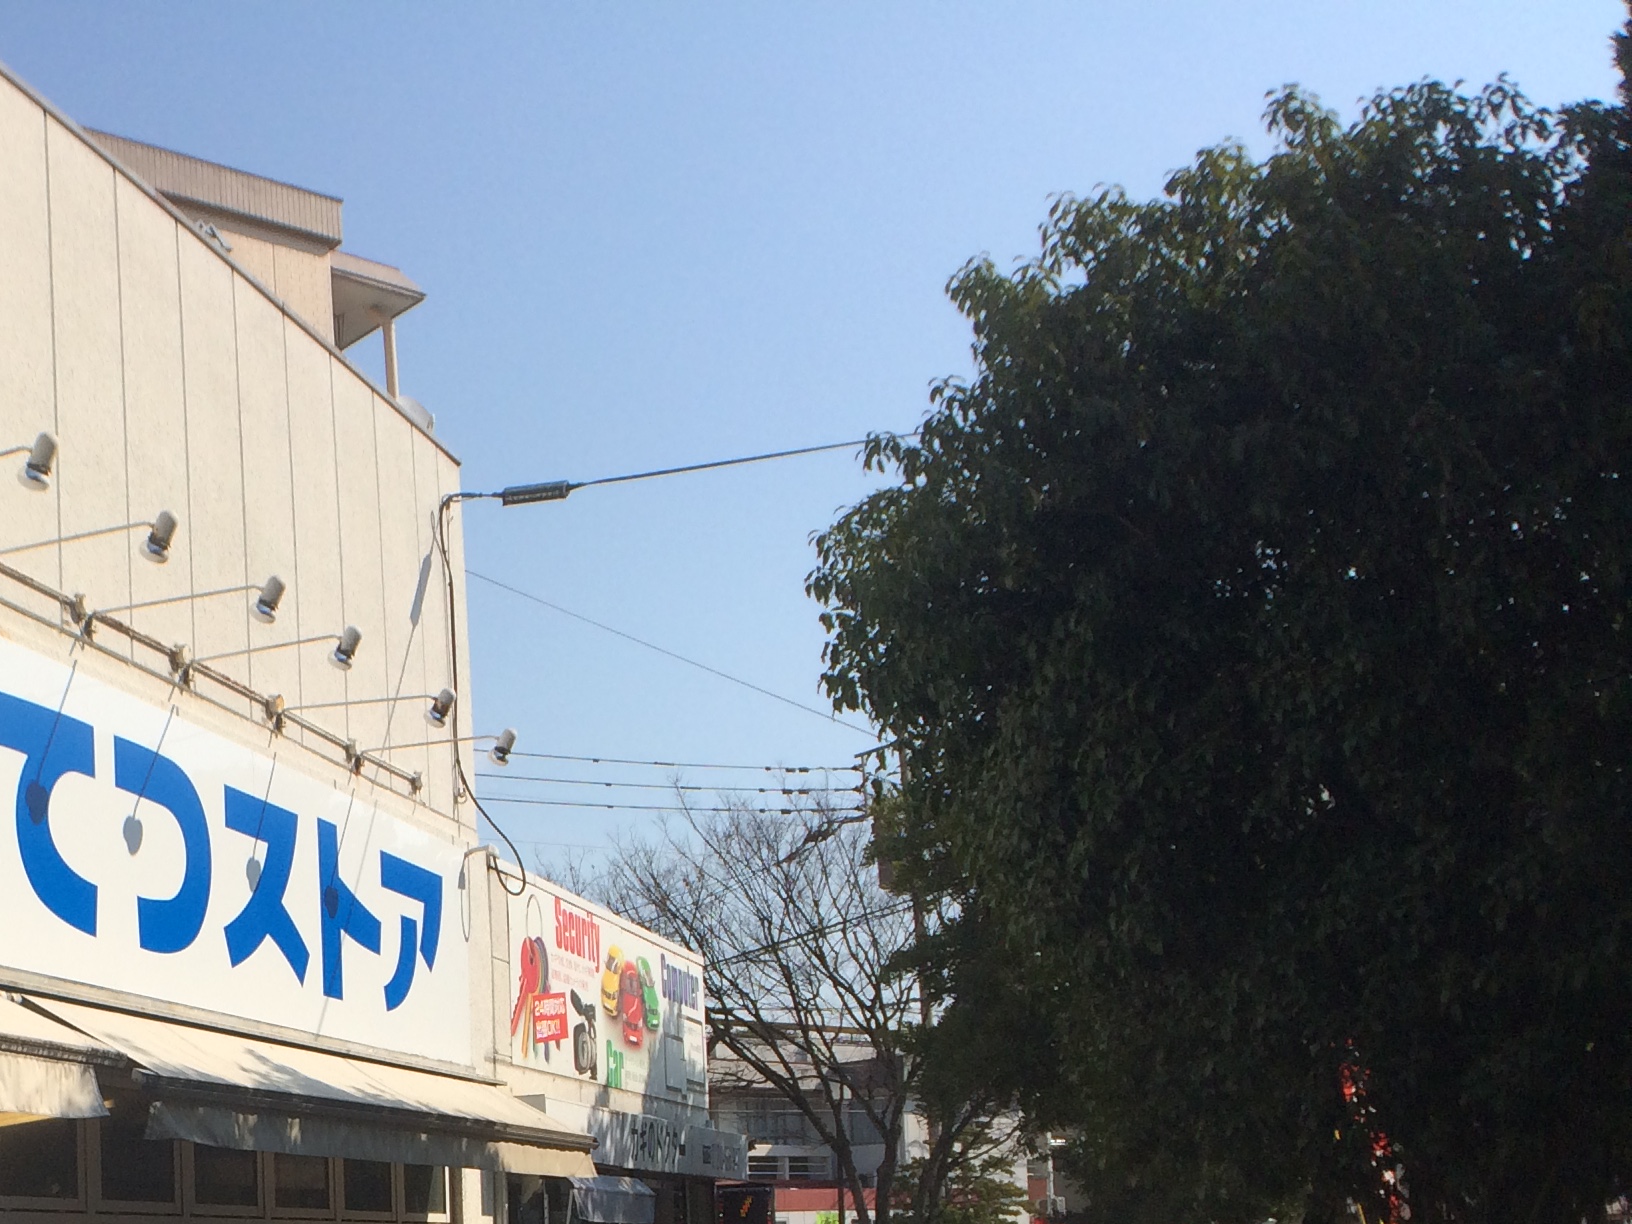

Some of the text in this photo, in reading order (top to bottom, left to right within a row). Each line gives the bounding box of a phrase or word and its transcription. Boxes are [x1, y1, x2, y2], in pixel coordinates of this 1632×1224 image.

[554, 896, 600, 973] Security
[660, 953, 699, 1011] Computer
[606, 1039, 624, 1088] Car
[630, 1118, 687, 1164] カギのドクター
